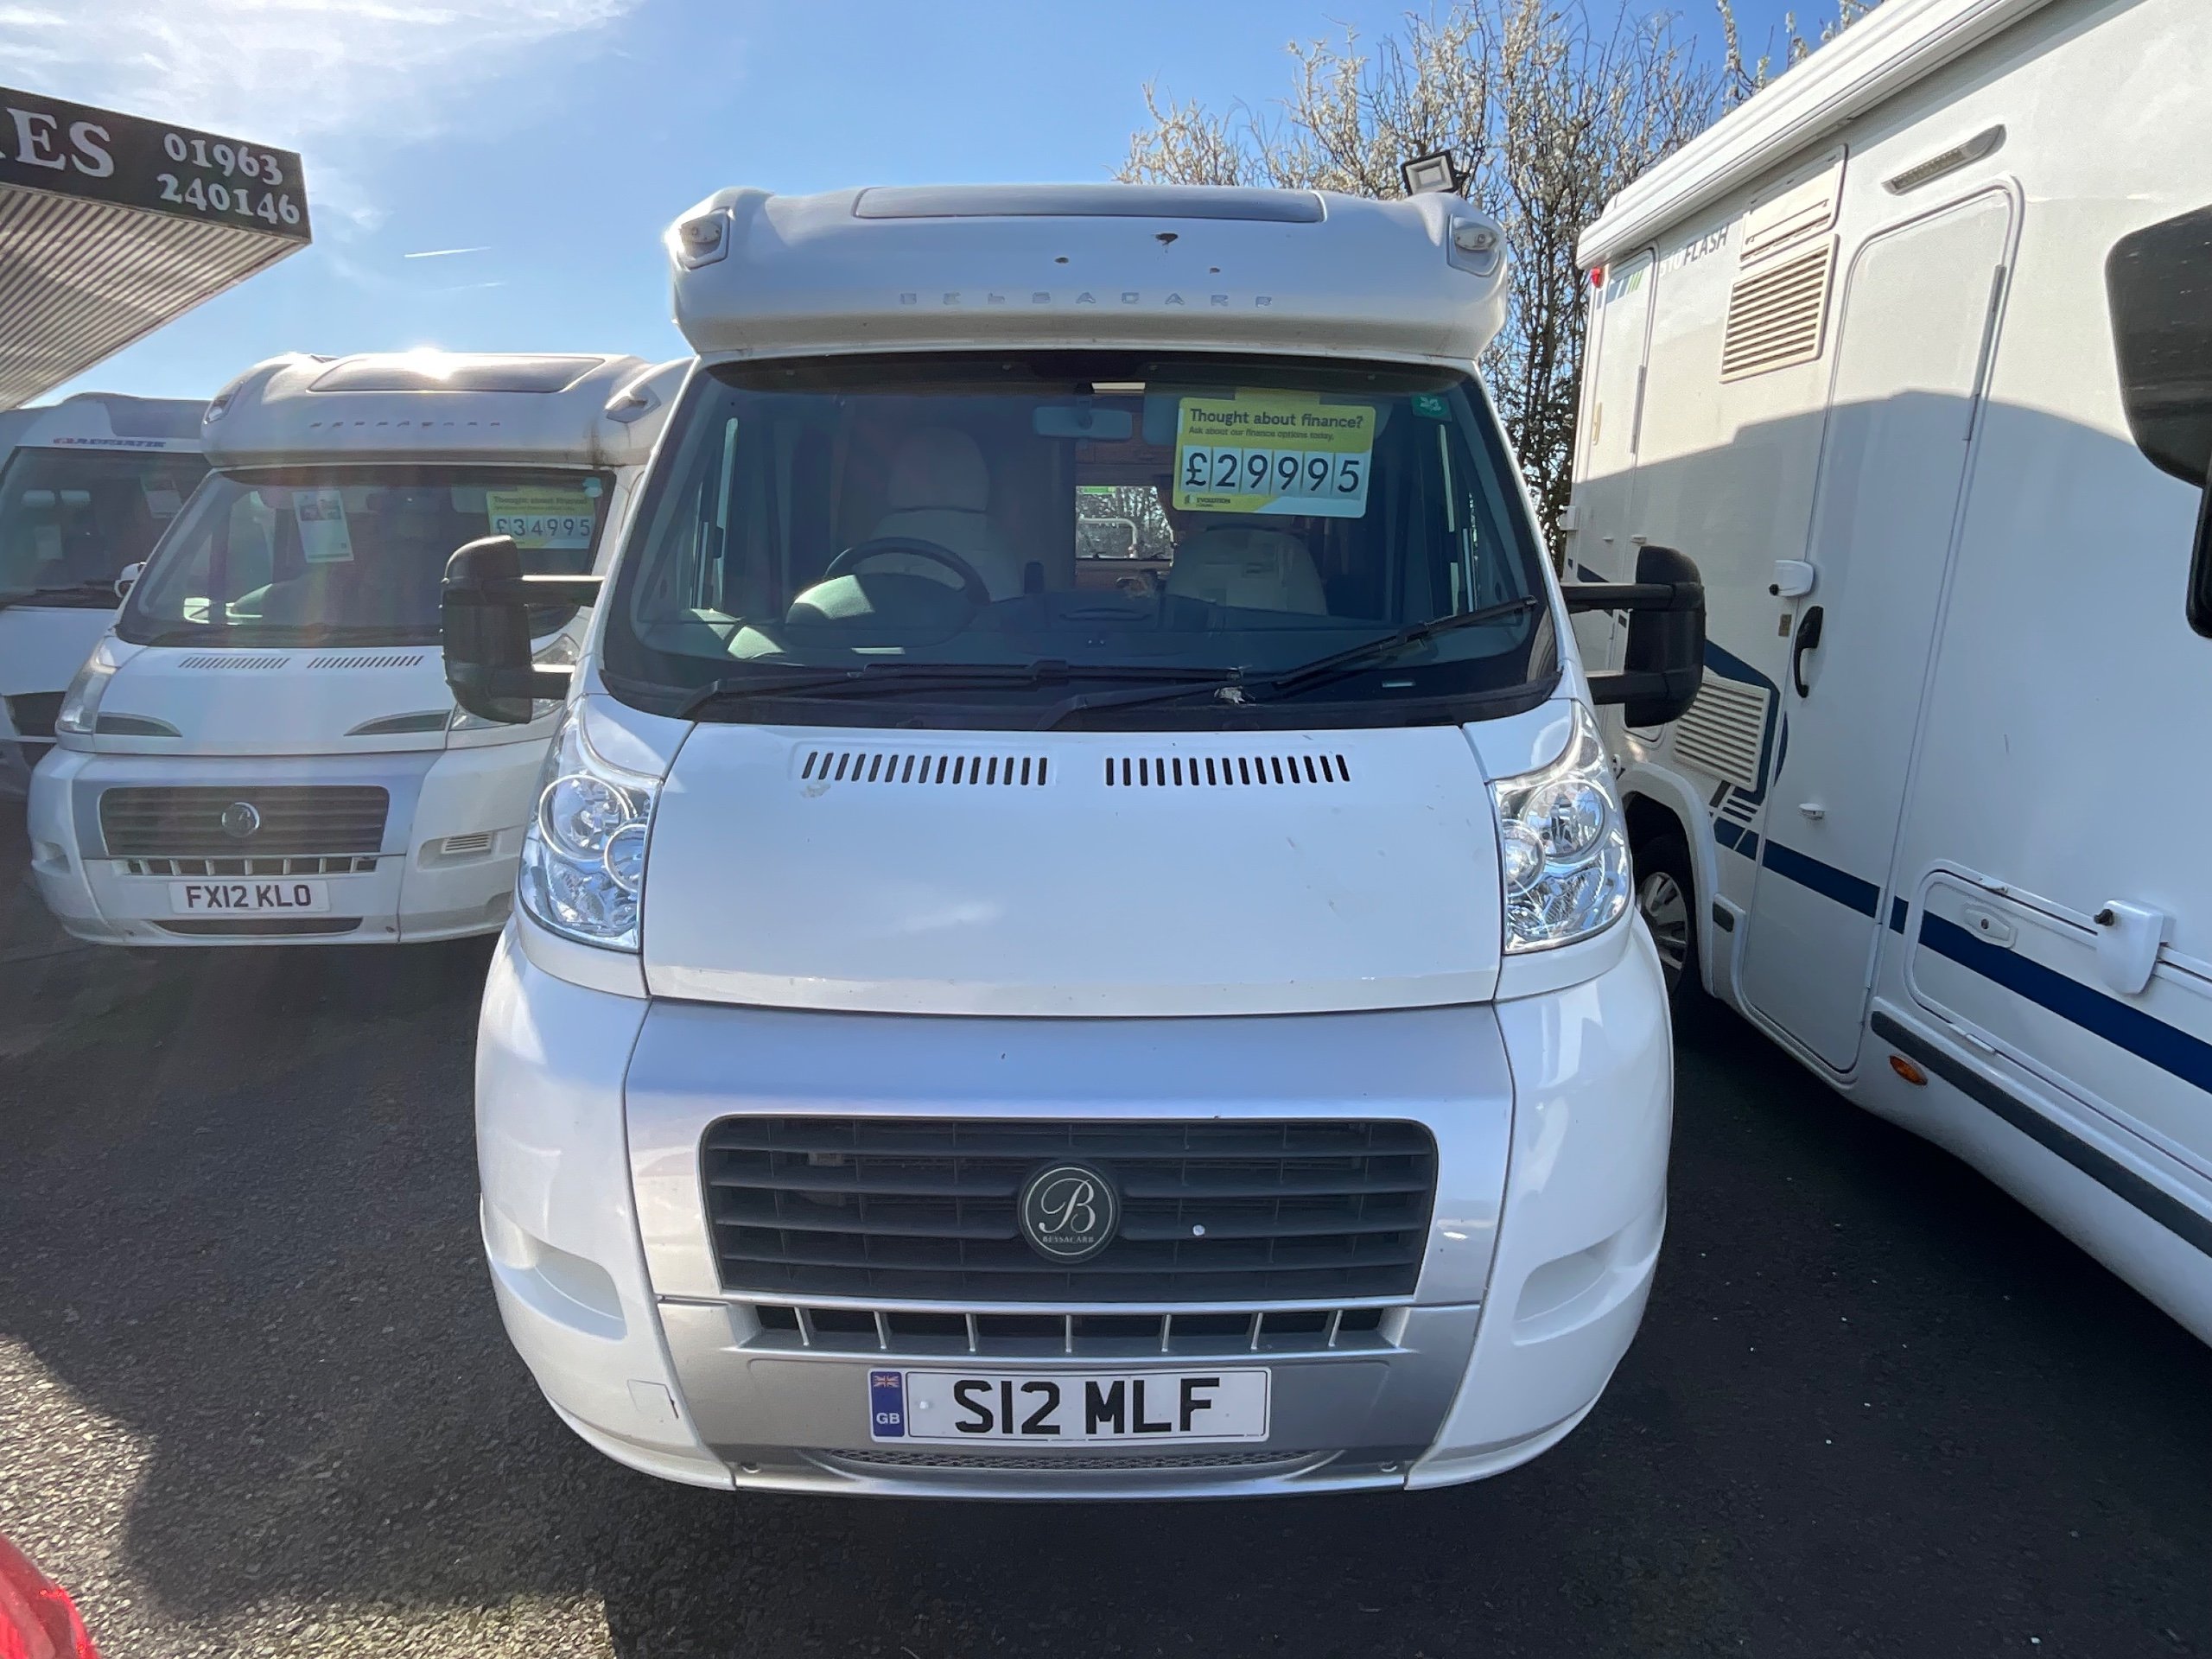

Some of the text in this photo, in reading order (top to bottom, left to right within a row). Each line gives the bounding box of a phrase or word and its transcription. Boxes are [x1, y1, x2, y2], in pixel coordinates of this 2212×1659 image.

[0, 107, 115, 177] ES
[164, 133, 283, 185] 01963
[156, 174, 300, 224] 240146
[1684, 222, 1729, 265] FLASH
[1189, 426, 1204, 435] Ask
[1205, 427, 1228, 435] about
[1245, 429, 1275, 437] finance
[1190, 408, 1363, 429] Thought about finance?
[1185, 451, 1361, 493] £29995
[496, 518, 590, 537] £34995
[186, 884, 311, 908] FX12 KLO
[1039, 1178, 1096, 1233] B
[876, 1411, 900, 1426] GB
[953, 1376, 1221, 1434] S12 MLF
